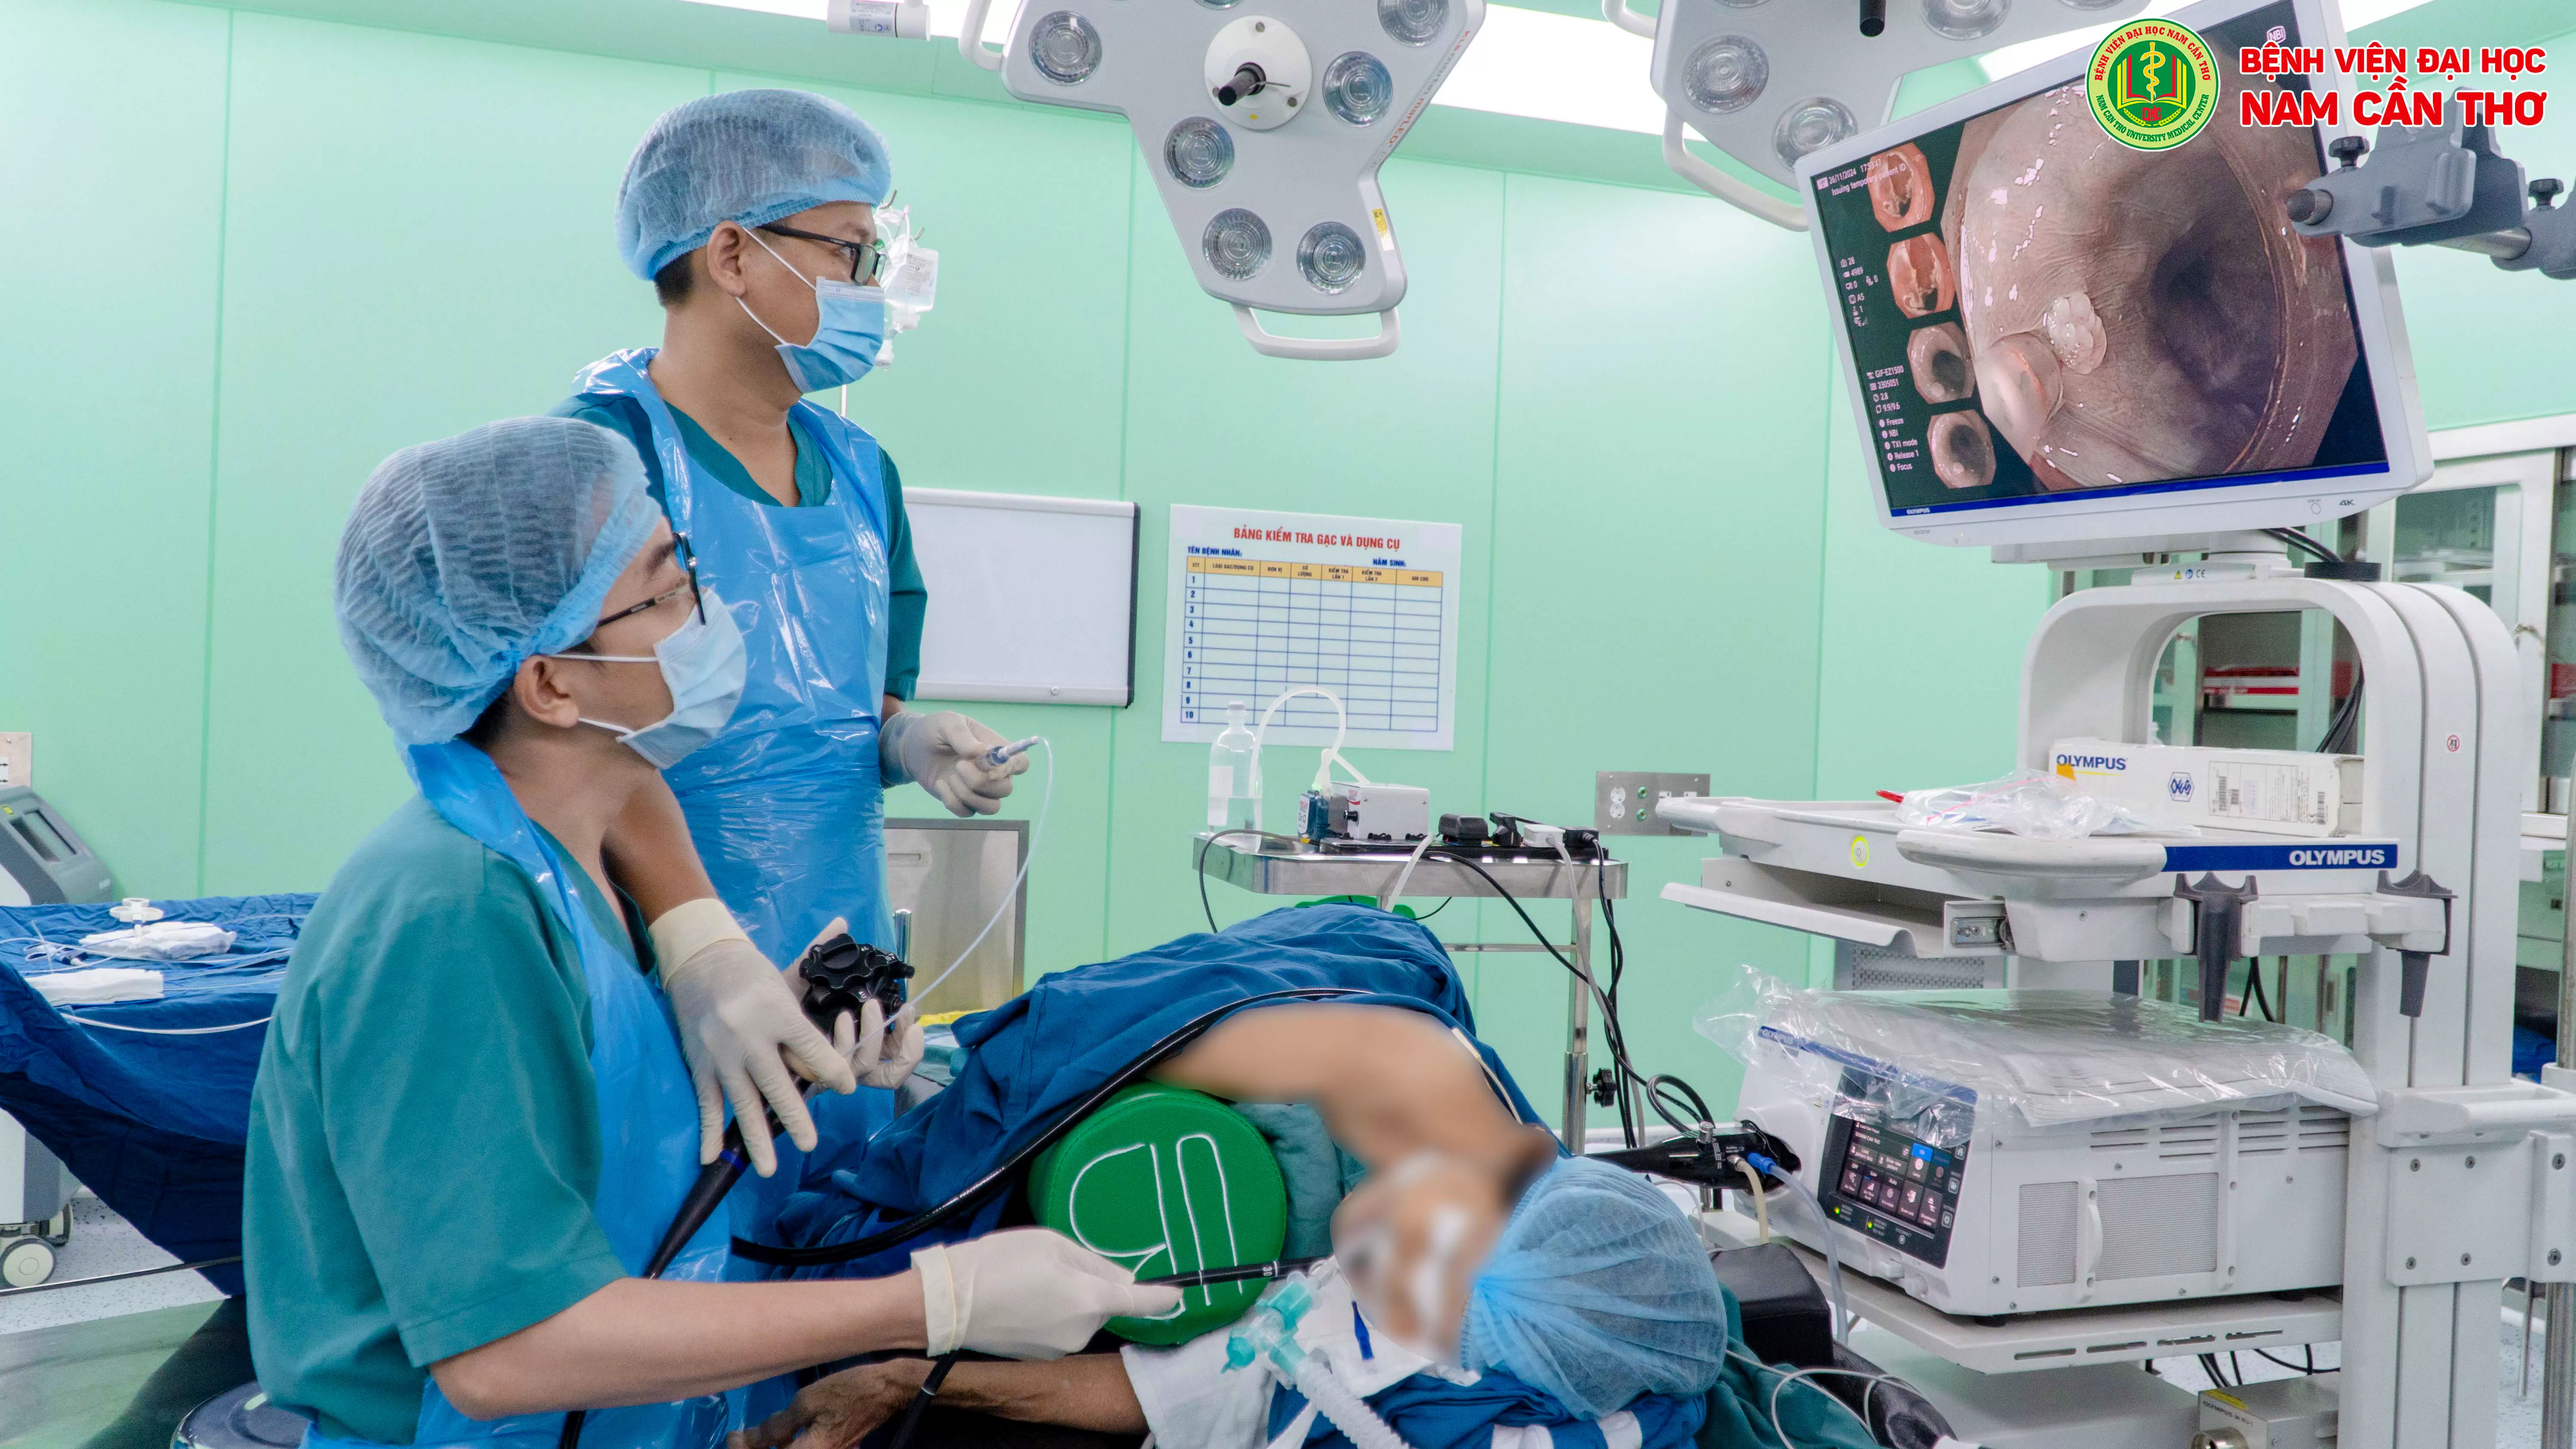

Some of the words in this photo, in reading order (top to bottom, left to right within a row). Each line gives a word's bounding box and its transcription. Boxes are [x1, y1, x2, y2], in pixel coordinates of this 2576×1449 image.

[1829, 168, 1857, 185] 26/11/2024
[1832, 184, 1850, 196] Issuing
[1850, 176, 1878, 190] temporary
[1878, 167, 1899, 179] patient
[1899, 163, 1906, 172] ID
[1875, 365, 1904, 378] GIF-EZ1500
[1902, 439, 1918, 447] mode
[1233, 524, 1262, 540] BẢNG
[1266, 526, 1291, 542] KIỂM
[1295, 532, 1313, 544] TRA
[1317, 534, 1337, 548] GẠC
[1341, 534, 1353, 546] VÀ
[1356, 537, 1383, 550] DỤNG
[1387, 538, 1400, 552] CỤ
[1188, 546, 1200, 554] TÊN
[1202, 546, 1219, 556] BỆNH
[2057, 754, 2126, 770] OLYMPUS
[2289, 849, 2385, 866] OLYMPUS
[1762, 1029, 1794, 1045] OLYMPUS
[1263, 1267, 1273, 1276] 30
